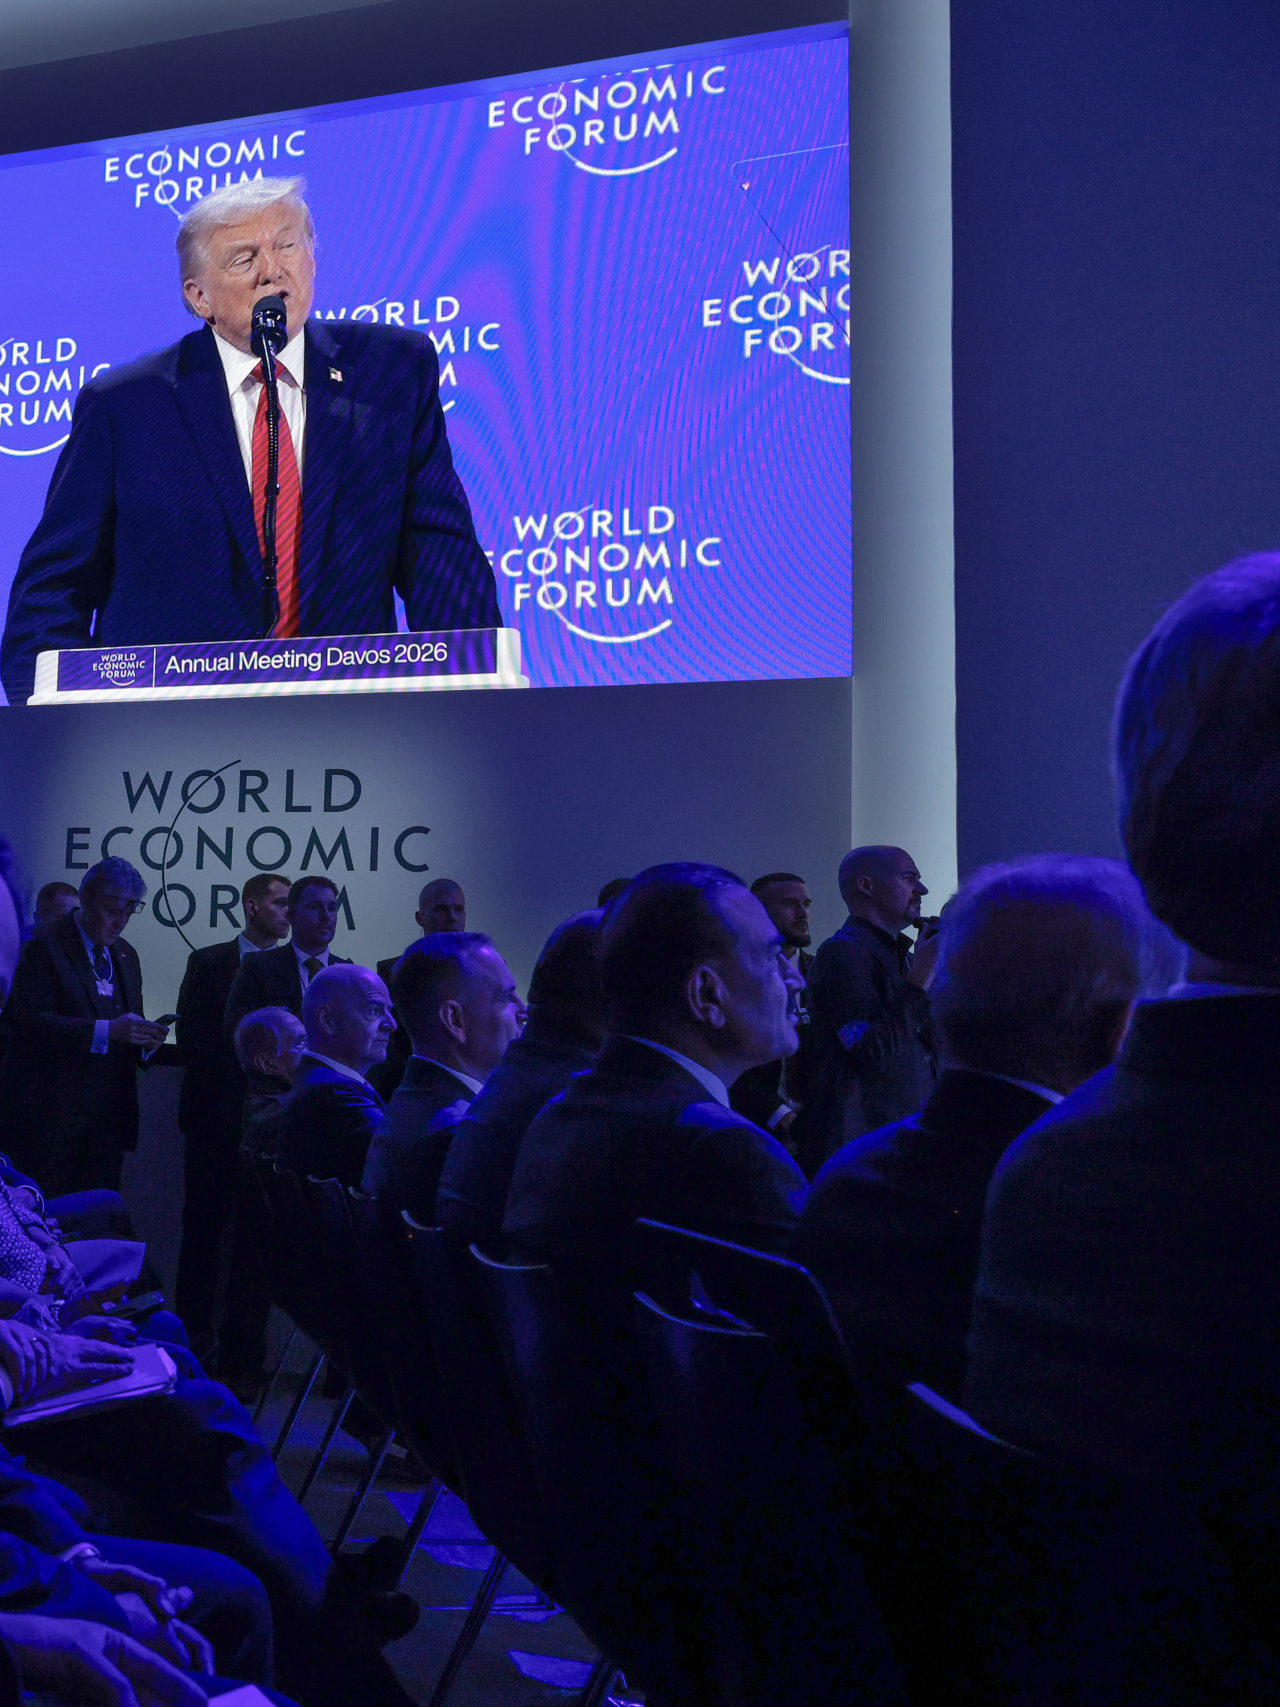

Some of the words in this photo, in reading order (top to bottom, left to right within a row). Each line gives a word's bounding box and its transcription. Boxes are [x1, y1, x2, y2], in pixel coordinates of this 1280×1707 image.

[488, 65, 726, 128] ECONOMIC
[524, 107, 680, 156] FORUM
[105, 130, 306, 182] ECONOMIC
[743, 319, 851, 359] FOR
[513, 505, 676, 542] WORLD
[514, 576, 675, 612] FORUM
[92, 660, 146, 672] ECONOMIC
[100, 652, 137, 663] WORLD
[100, 669, 136, 680] FORUM
[164, 652, 234, 675] Annual
[238, 649, 322, 672] Meeting
[326, 647, 391, 667] Davos
[394, 642, 448, 663] 2026
[122, 767, 363, 815] WORLD
[64, 825, 432, 873] ECONOMIC
